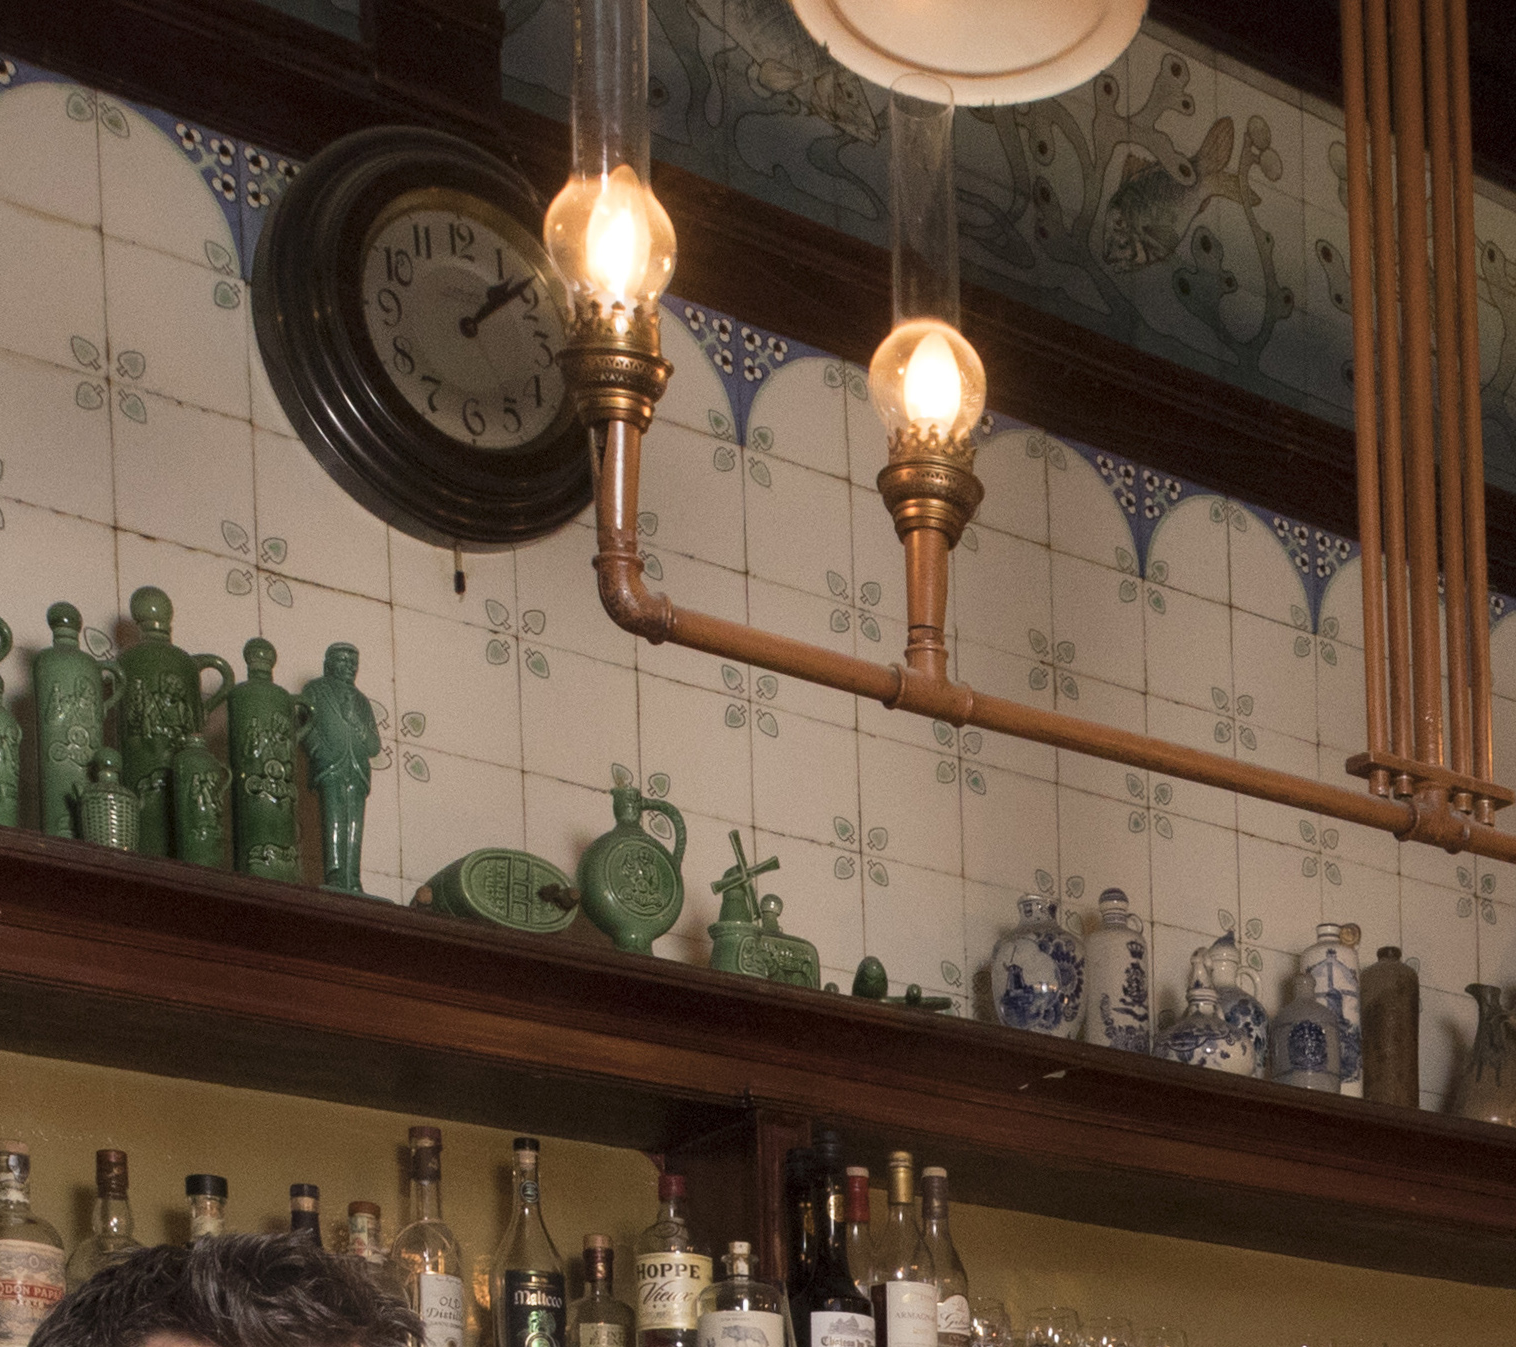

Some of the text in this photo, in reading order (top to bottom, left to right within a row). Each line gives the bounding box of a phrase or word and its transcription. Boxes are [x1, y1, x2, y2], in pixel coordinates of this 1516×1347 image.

[412, 224, 432, 260] 11
[449, 222, 475, 264] 12
[385, 246, 414, 287] 10
[496, 249, 504, 281] 1
[378, 288, 403, 328] 9
[393, 335, 415, 376] 8
[534, 330, 554, 370] 3
[421, 374, 441, 414] 7
[523, 374, 542, 409] 4
[463, 398, 485, 437] 6
[503, 396, 522, 434] 5
[5, 1285, 31, 1296] DON
[636, 1263, 701, 1280] HOPPE
